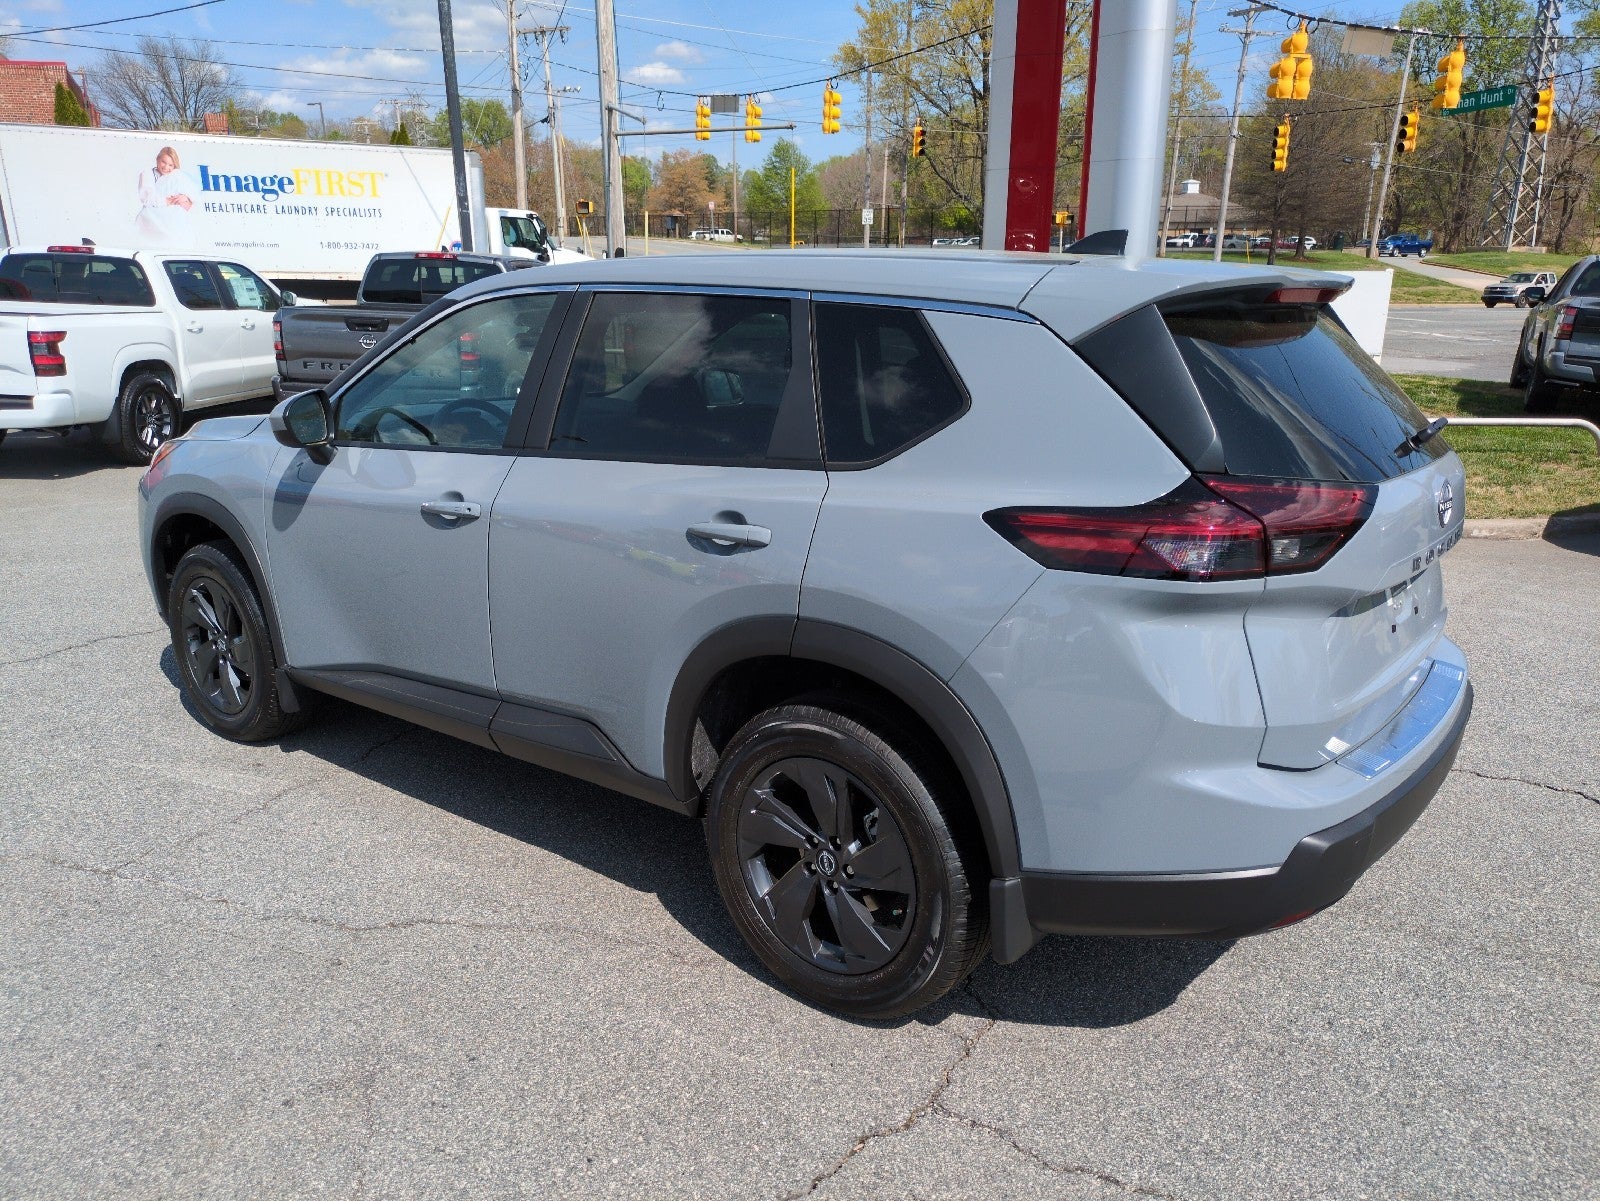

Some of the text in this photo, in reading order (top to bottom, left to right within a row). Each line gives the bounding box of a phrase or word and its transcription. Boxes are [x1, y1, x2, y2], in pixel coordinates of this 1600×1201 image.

[1480, 90, 1504, 105] Hunt
[204, 202, 383, 218] HEALTHCARE LAUNDRY SPECIALISTS
[214, 240, 280, 249] www.imagefirst.com
[320, 241, 379, 250] 1-800-932-7472
